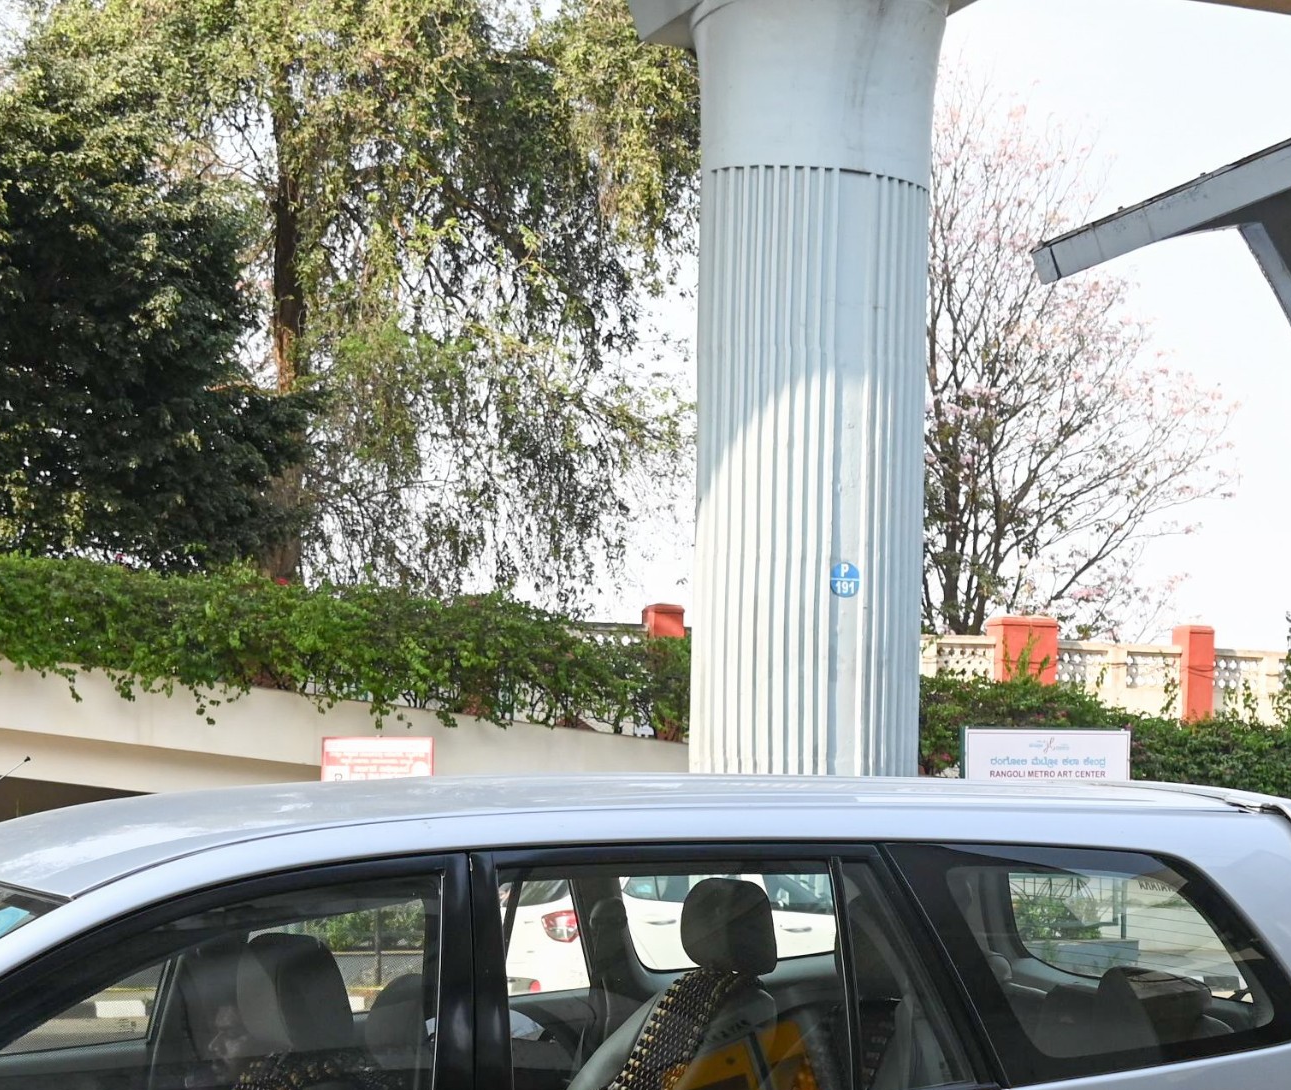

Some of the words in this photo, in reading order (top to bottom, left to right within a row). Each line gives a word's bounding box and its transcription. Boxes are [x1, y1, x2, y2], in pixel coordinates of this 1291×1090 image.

[840, 563, 849, 577] P
[835, 581, 855, 594] 191
[989, 770, 1025, 778] RANGOLI
[1027, 770, 1055, 778] METRO
[1057, 770, 1073, 778] ART
[1075, 770, 1106, 778] CENTER
